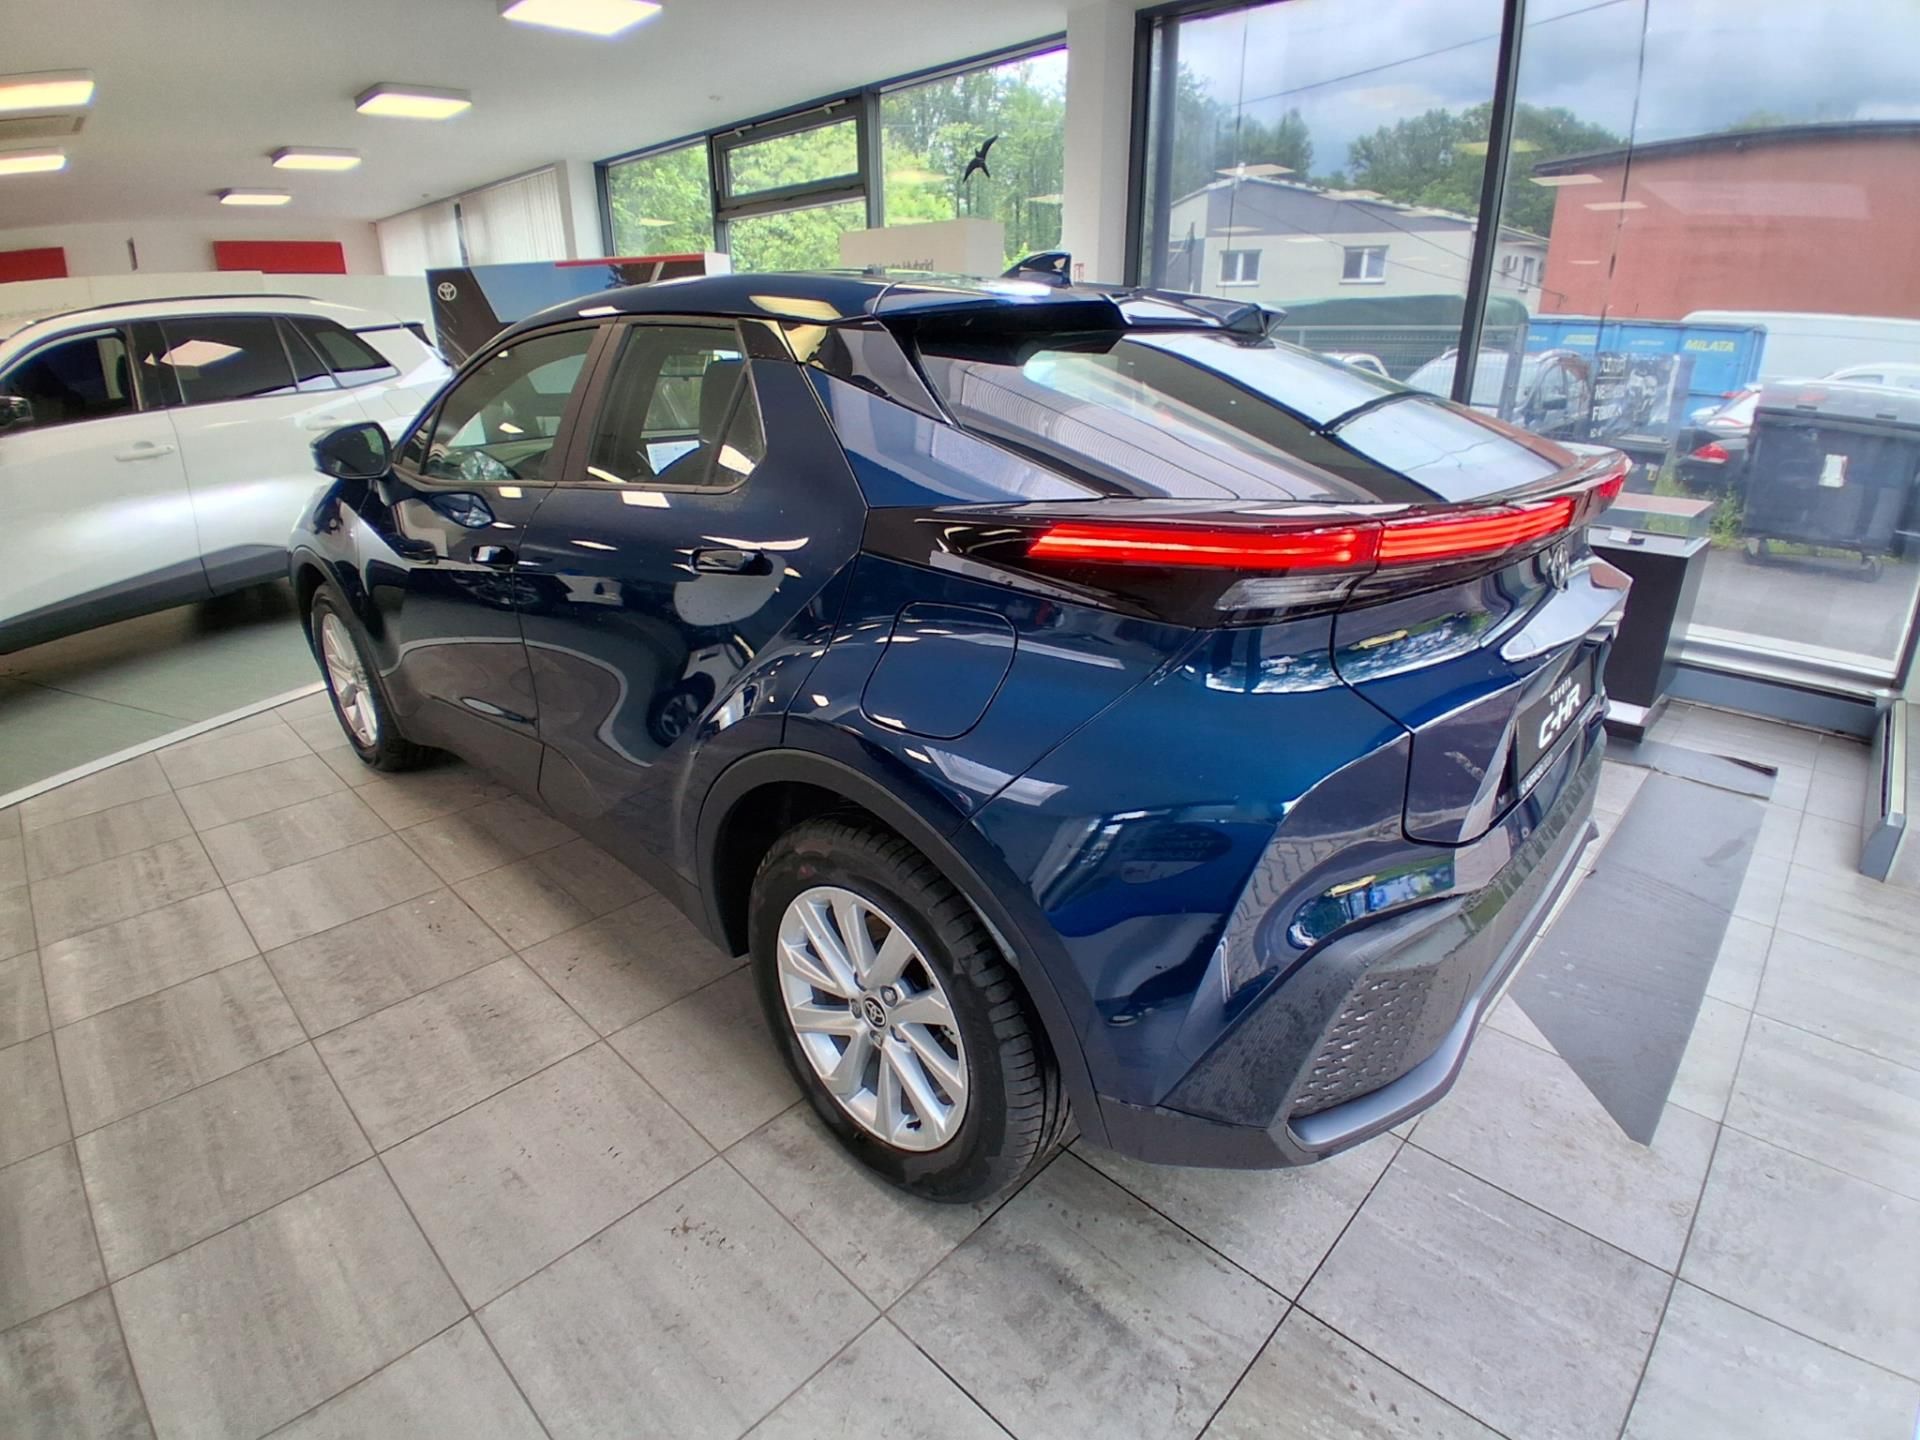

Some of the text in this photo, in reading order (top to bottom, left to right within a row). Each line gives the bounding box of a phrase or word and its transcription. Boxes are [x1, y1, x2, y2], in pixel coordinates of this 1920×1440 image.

[1684, 338, 1737, 353] MILATA
[1549, 676, 1572, 706] TOYOTA
[1538, 683, 1582, 749] C-HR
